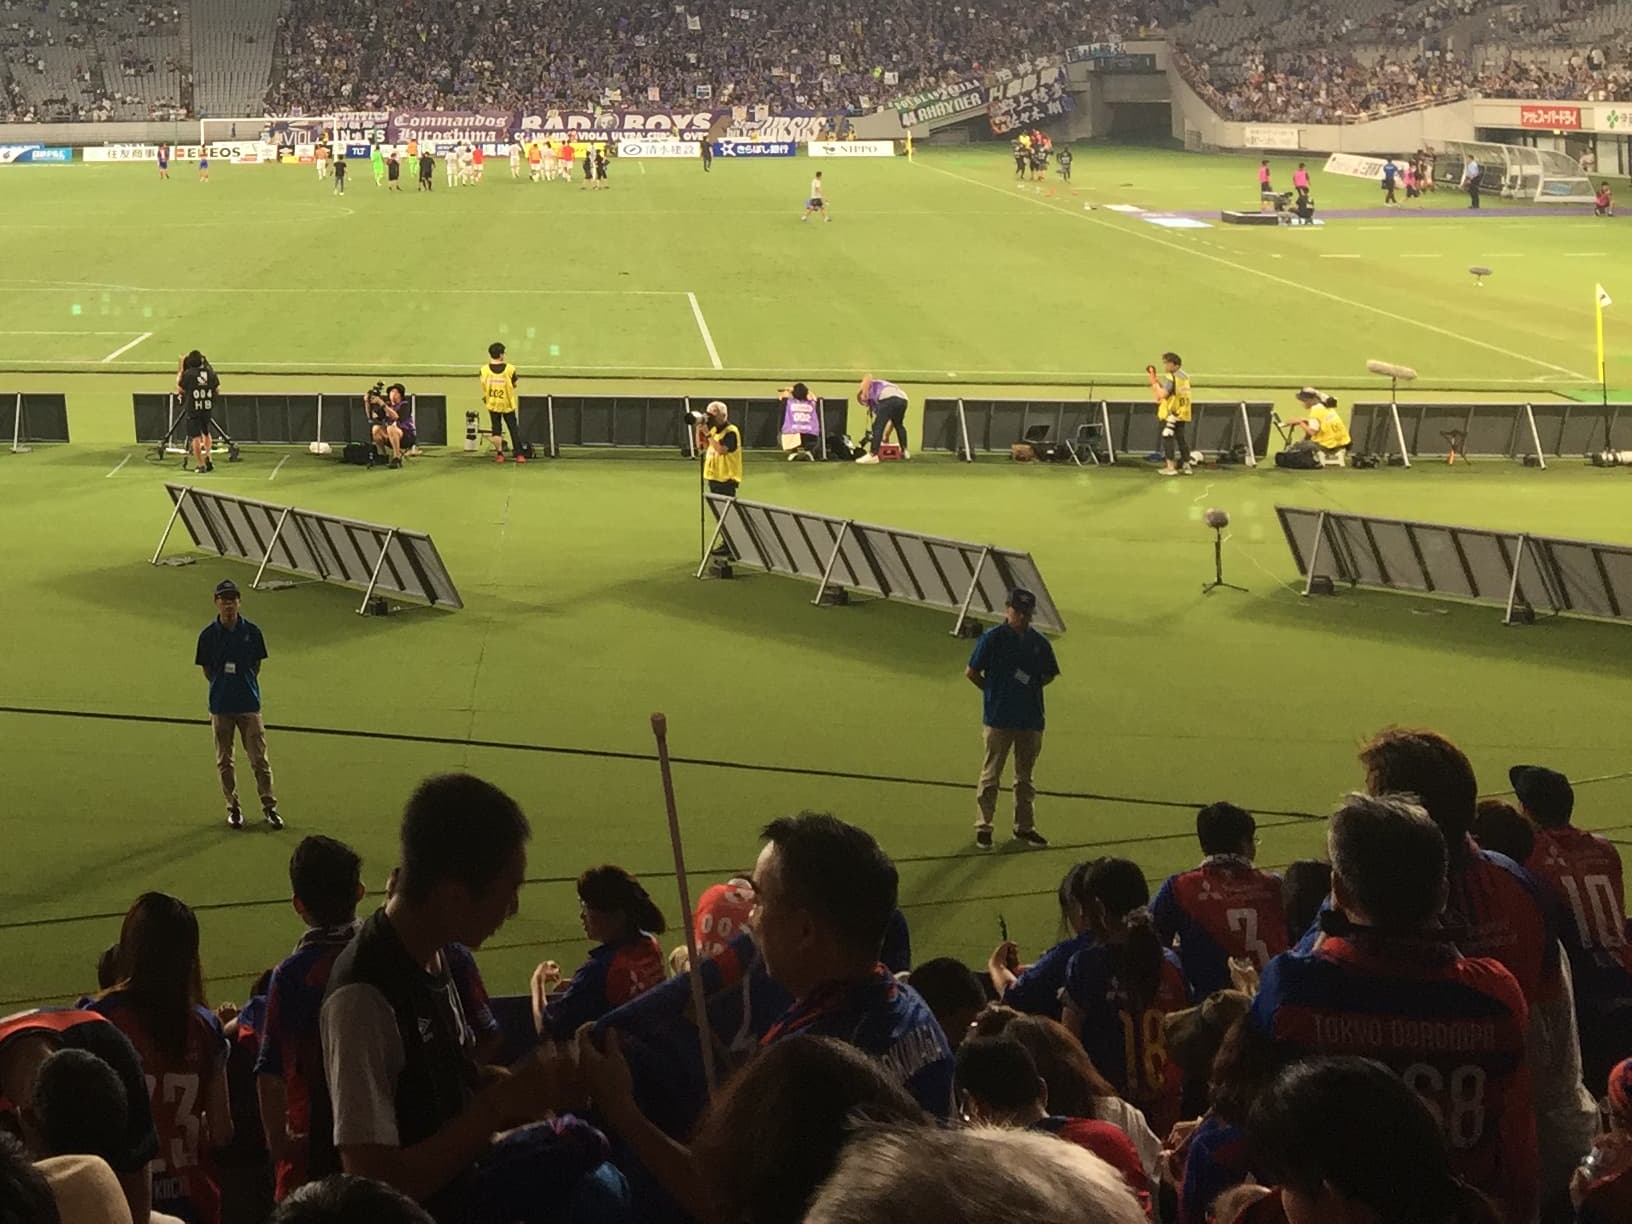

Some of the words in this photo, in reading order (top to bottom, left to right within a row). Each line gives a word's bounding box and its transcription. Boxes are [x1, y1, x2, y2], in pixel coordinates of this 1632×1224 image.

[393, 114, 508, 127] Commandos
[521, 114, 592, 130] BAD
[623, 113, 713, 130] BOYS
[187, 147, 241, 158] EEOS
[840, 144, 878, 154] NIPPO
[1311, 1014, 1383, 1046] TOKYO
[1118, 1007, 1169, 1090] 18
